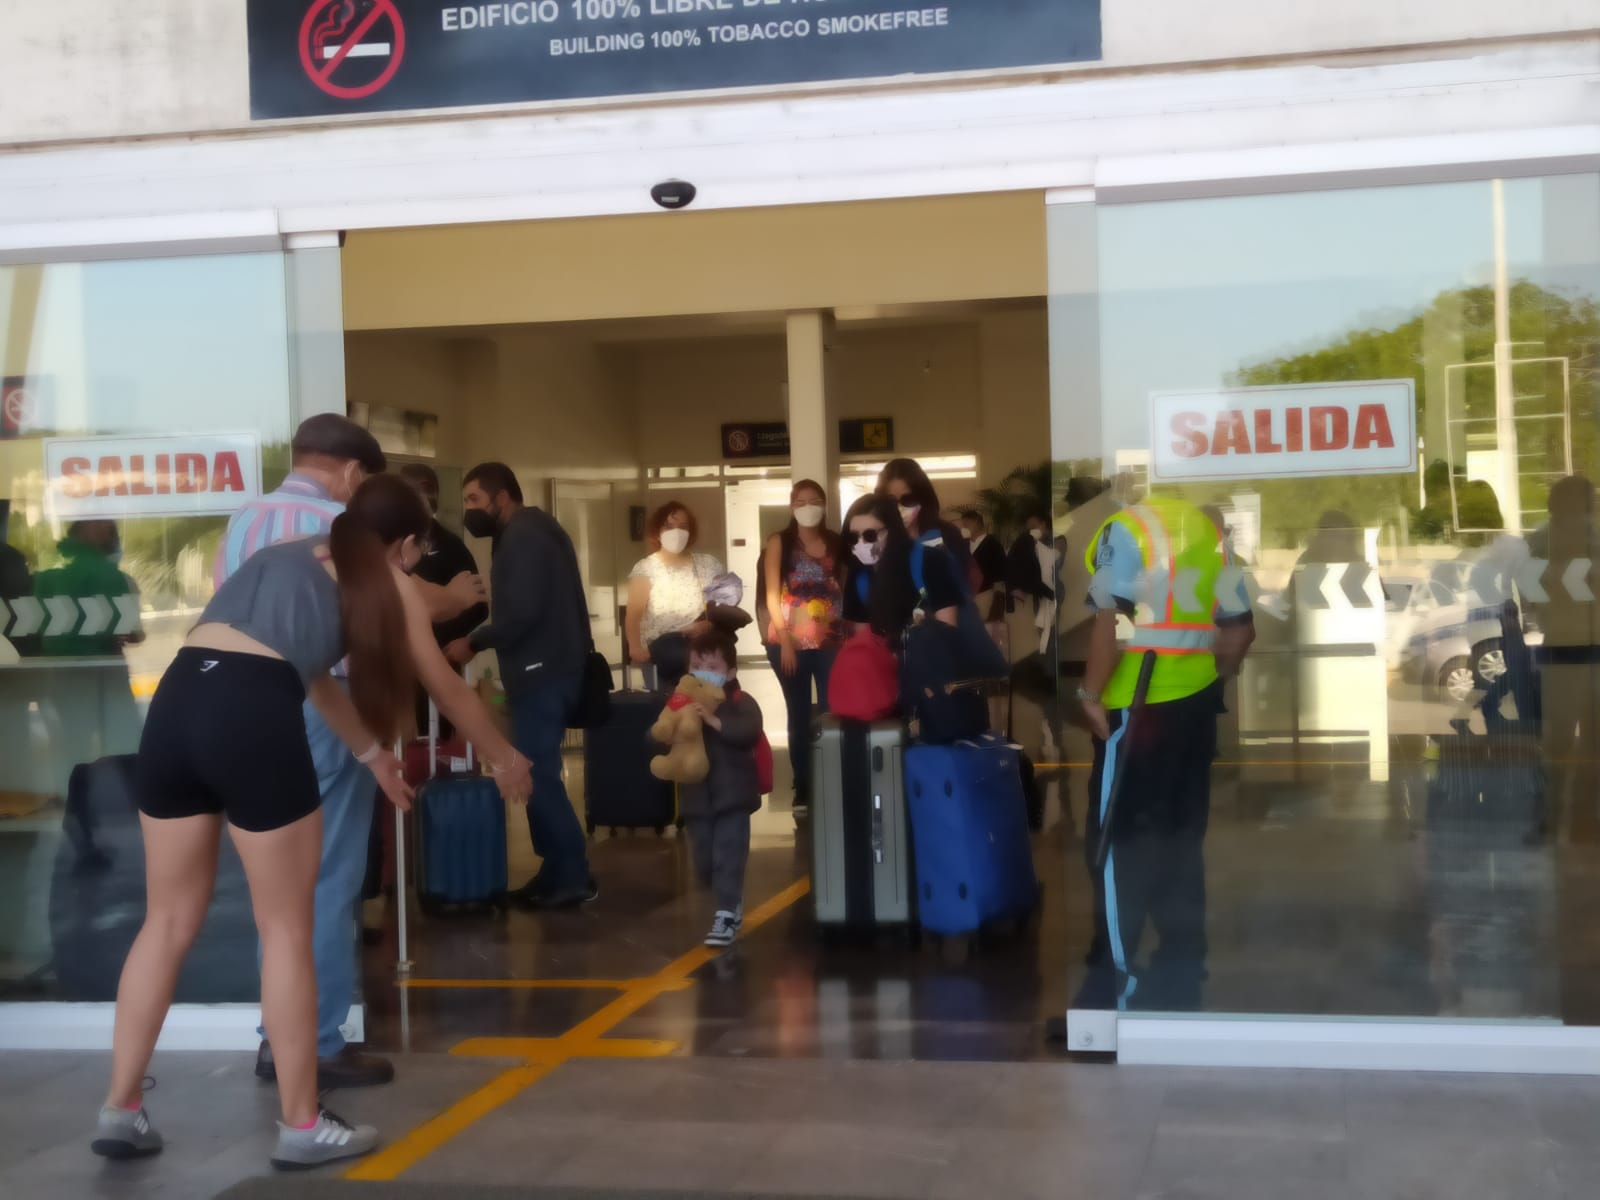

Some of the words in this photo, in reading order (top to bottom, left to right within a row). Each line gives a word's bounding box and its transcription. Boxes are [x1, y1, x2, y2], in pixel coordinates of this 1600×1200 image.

[441, 0, 560, 31] EDIFICIO
[572, 0, 641, 20] 100%
[550, 32, 645, 55] BUILDING
[650, 29, 701, 48] 100%
[707, 19, 810, 43] TOBACCO
[817, 8, 948, 36] SMOKEFREE
[1170, 403, 1395, 457] SALIDA
[61, 451, 245, 498] SALIDA
